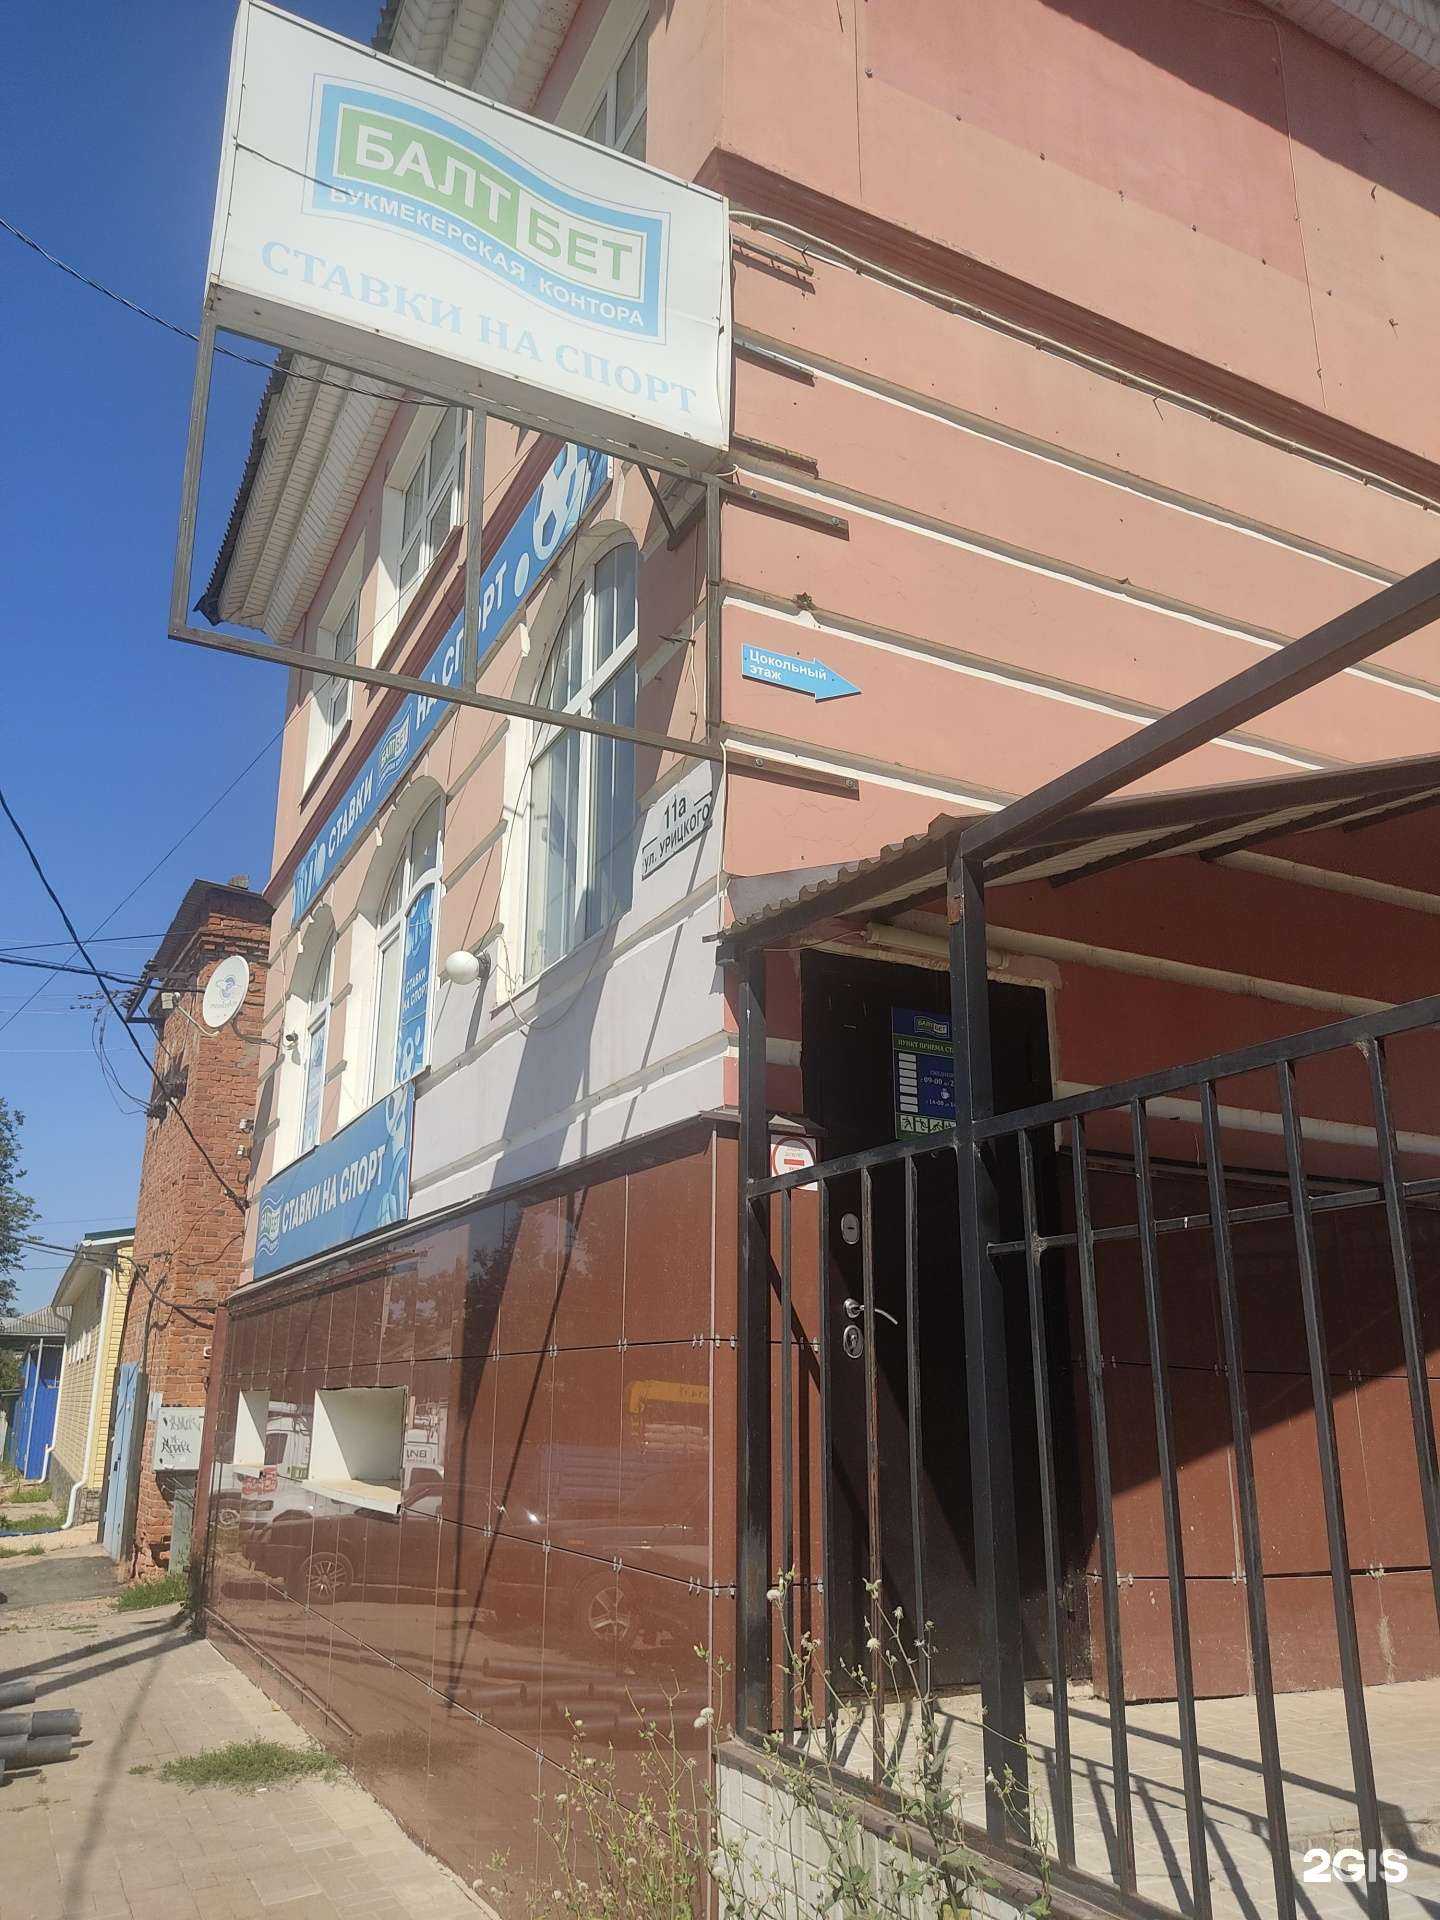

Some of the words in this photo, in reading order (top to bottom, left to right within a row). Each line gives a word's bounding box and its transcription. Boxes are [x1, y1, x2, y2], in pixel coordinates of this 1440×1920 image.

[330, 186, 526, 283] БУКМЕКЕРСКАЯ
[540, 277, 645, 327] КОНТОРА
[260, 240, 465, 336] СТАВКИ
[478, 313, 544, 363] НА
[555, 344, 697, 414] СПОРТ
[749, 649, 828, 681] Цокольный
[749, 664, 782, 681] этаж
[327, 767, 374, 859] СТАВКИ
[643, 850, 658, 873] ул.
[659, 803, 711, 858] УРИЦКОГО
[664, 792, 688, 829] 11а
[281, 1184, 321, 1235] СТАВКИ
[321, 1173, 338, 1215] НА
[339, 1144, 387, 1204] СПОРТ
